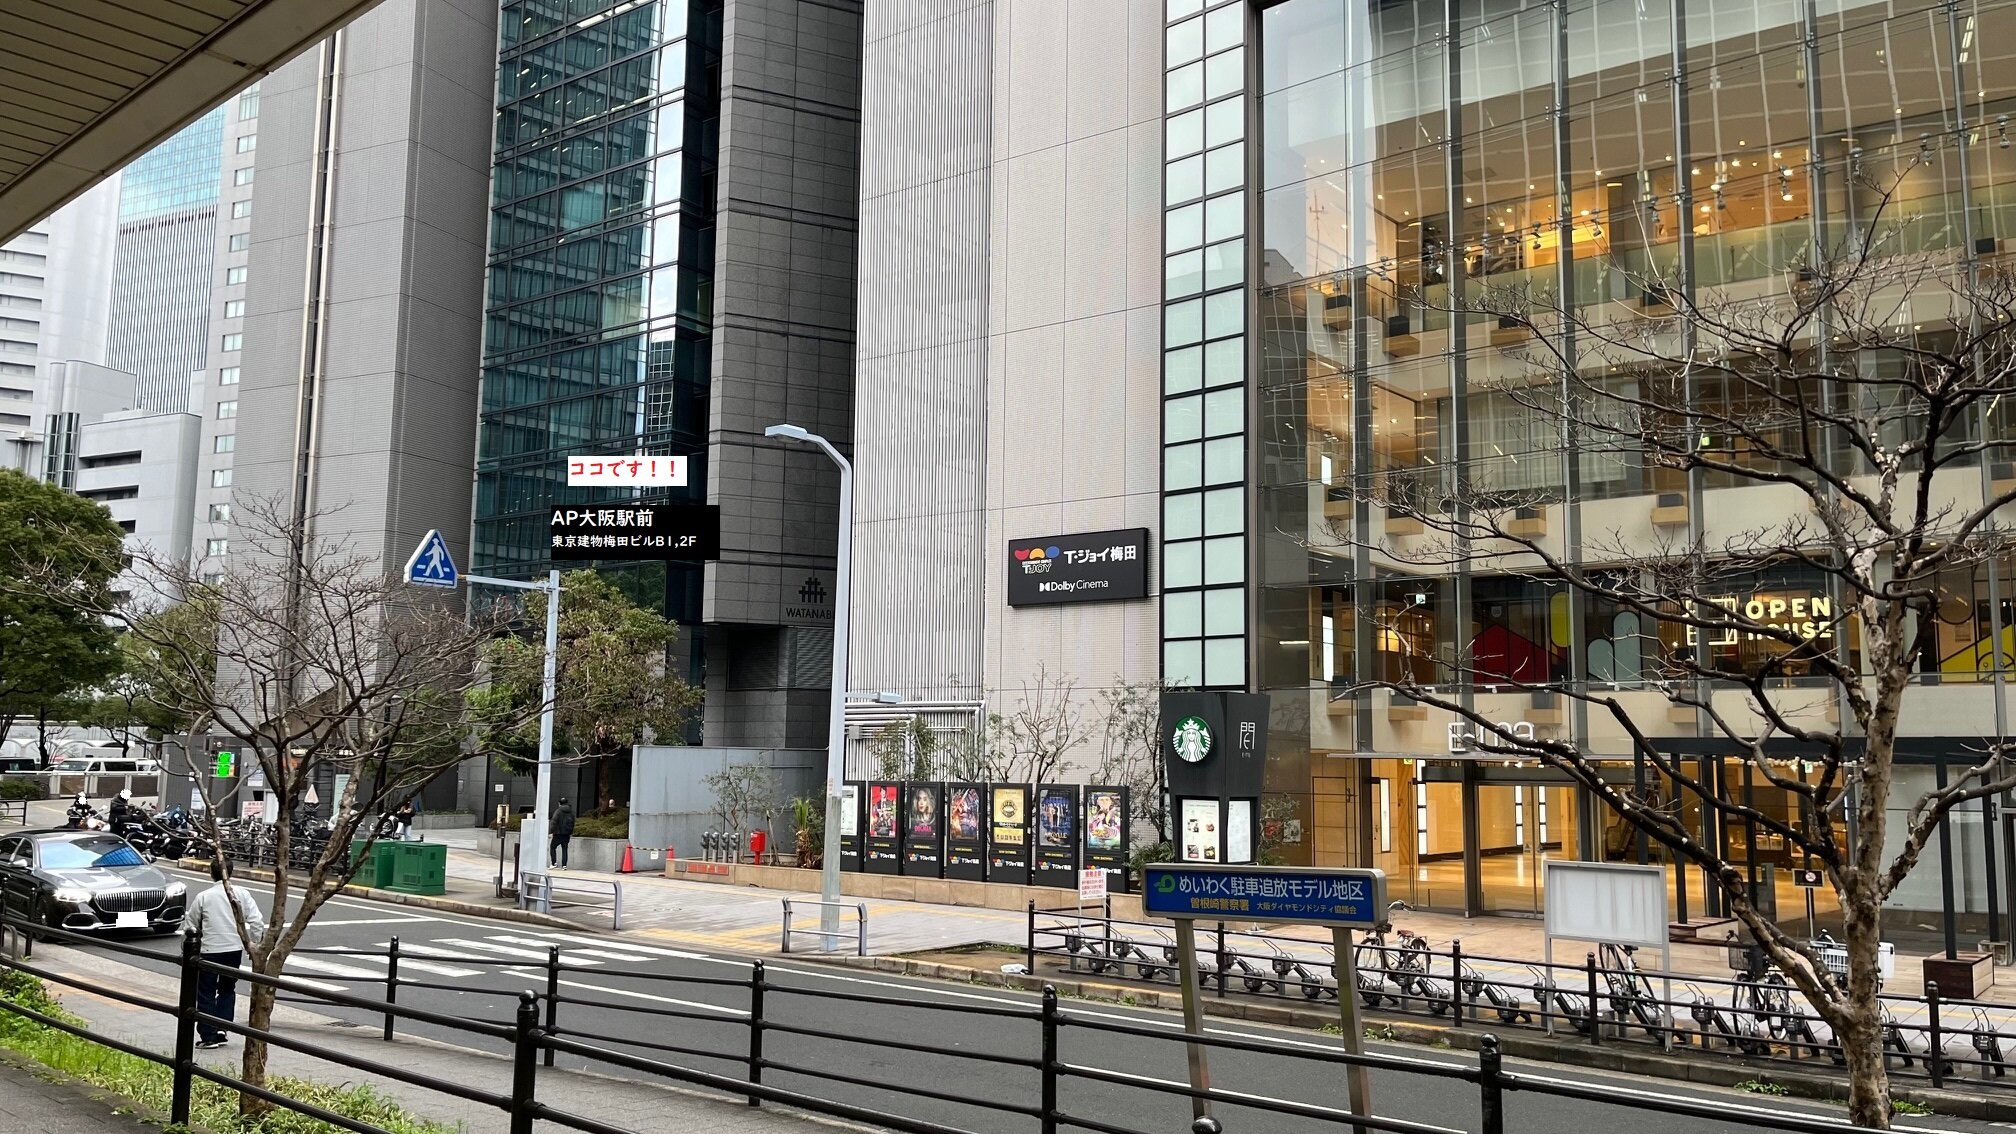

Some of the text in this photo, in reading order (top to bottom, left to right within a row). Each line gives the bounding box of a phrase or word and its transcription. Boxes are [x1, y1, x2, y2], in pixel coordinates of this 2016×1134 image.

[1050, 579, 1109, 592] Dolby Cinema
[785, 607, 832, 620] WATANAB
[1745, 597, 1831, 620] OPEN
[1179, 876, 1365, 901] めいわく駐車追放モデル地区
[1256, 902, 1357, 915] 大阪ダイヤモンドシティ協議会
